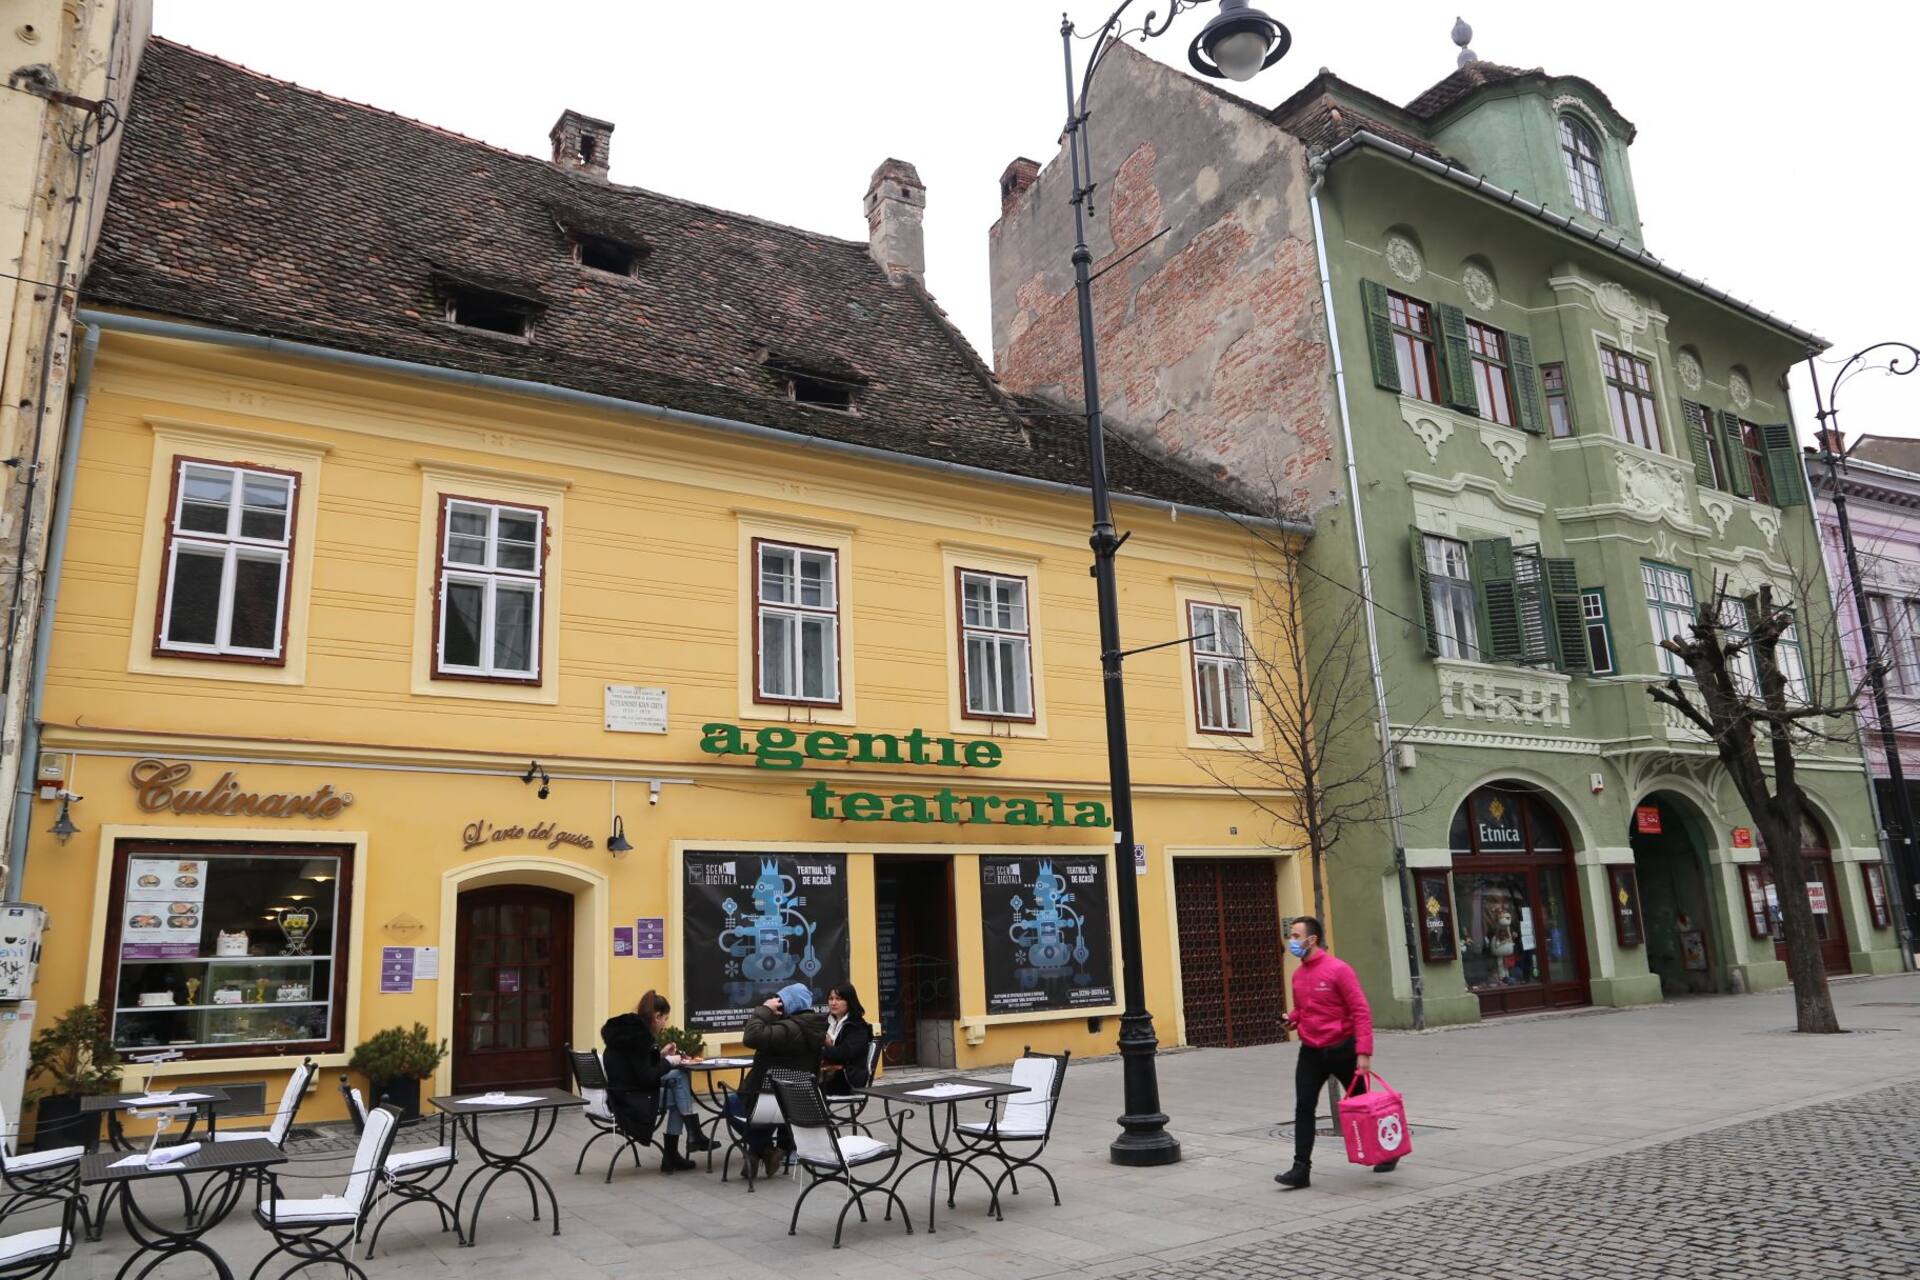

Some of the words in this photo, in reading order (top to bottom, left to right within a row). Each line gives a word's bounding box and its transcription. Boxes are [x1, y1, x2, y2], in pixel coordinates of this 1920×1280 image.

[806, 781, 1113, 828] teatrala
[463, 819, 524, 851] L'arte
[527, 821, 556, 840] del
[548, 831, 594, 850] gusto
[1479, 823, 1520, 843] Etnica
[797, 865, 823, 875] TEATRUL
[802, 876, 811, 885] DE
[1071, 875, 1078, 883] DE
